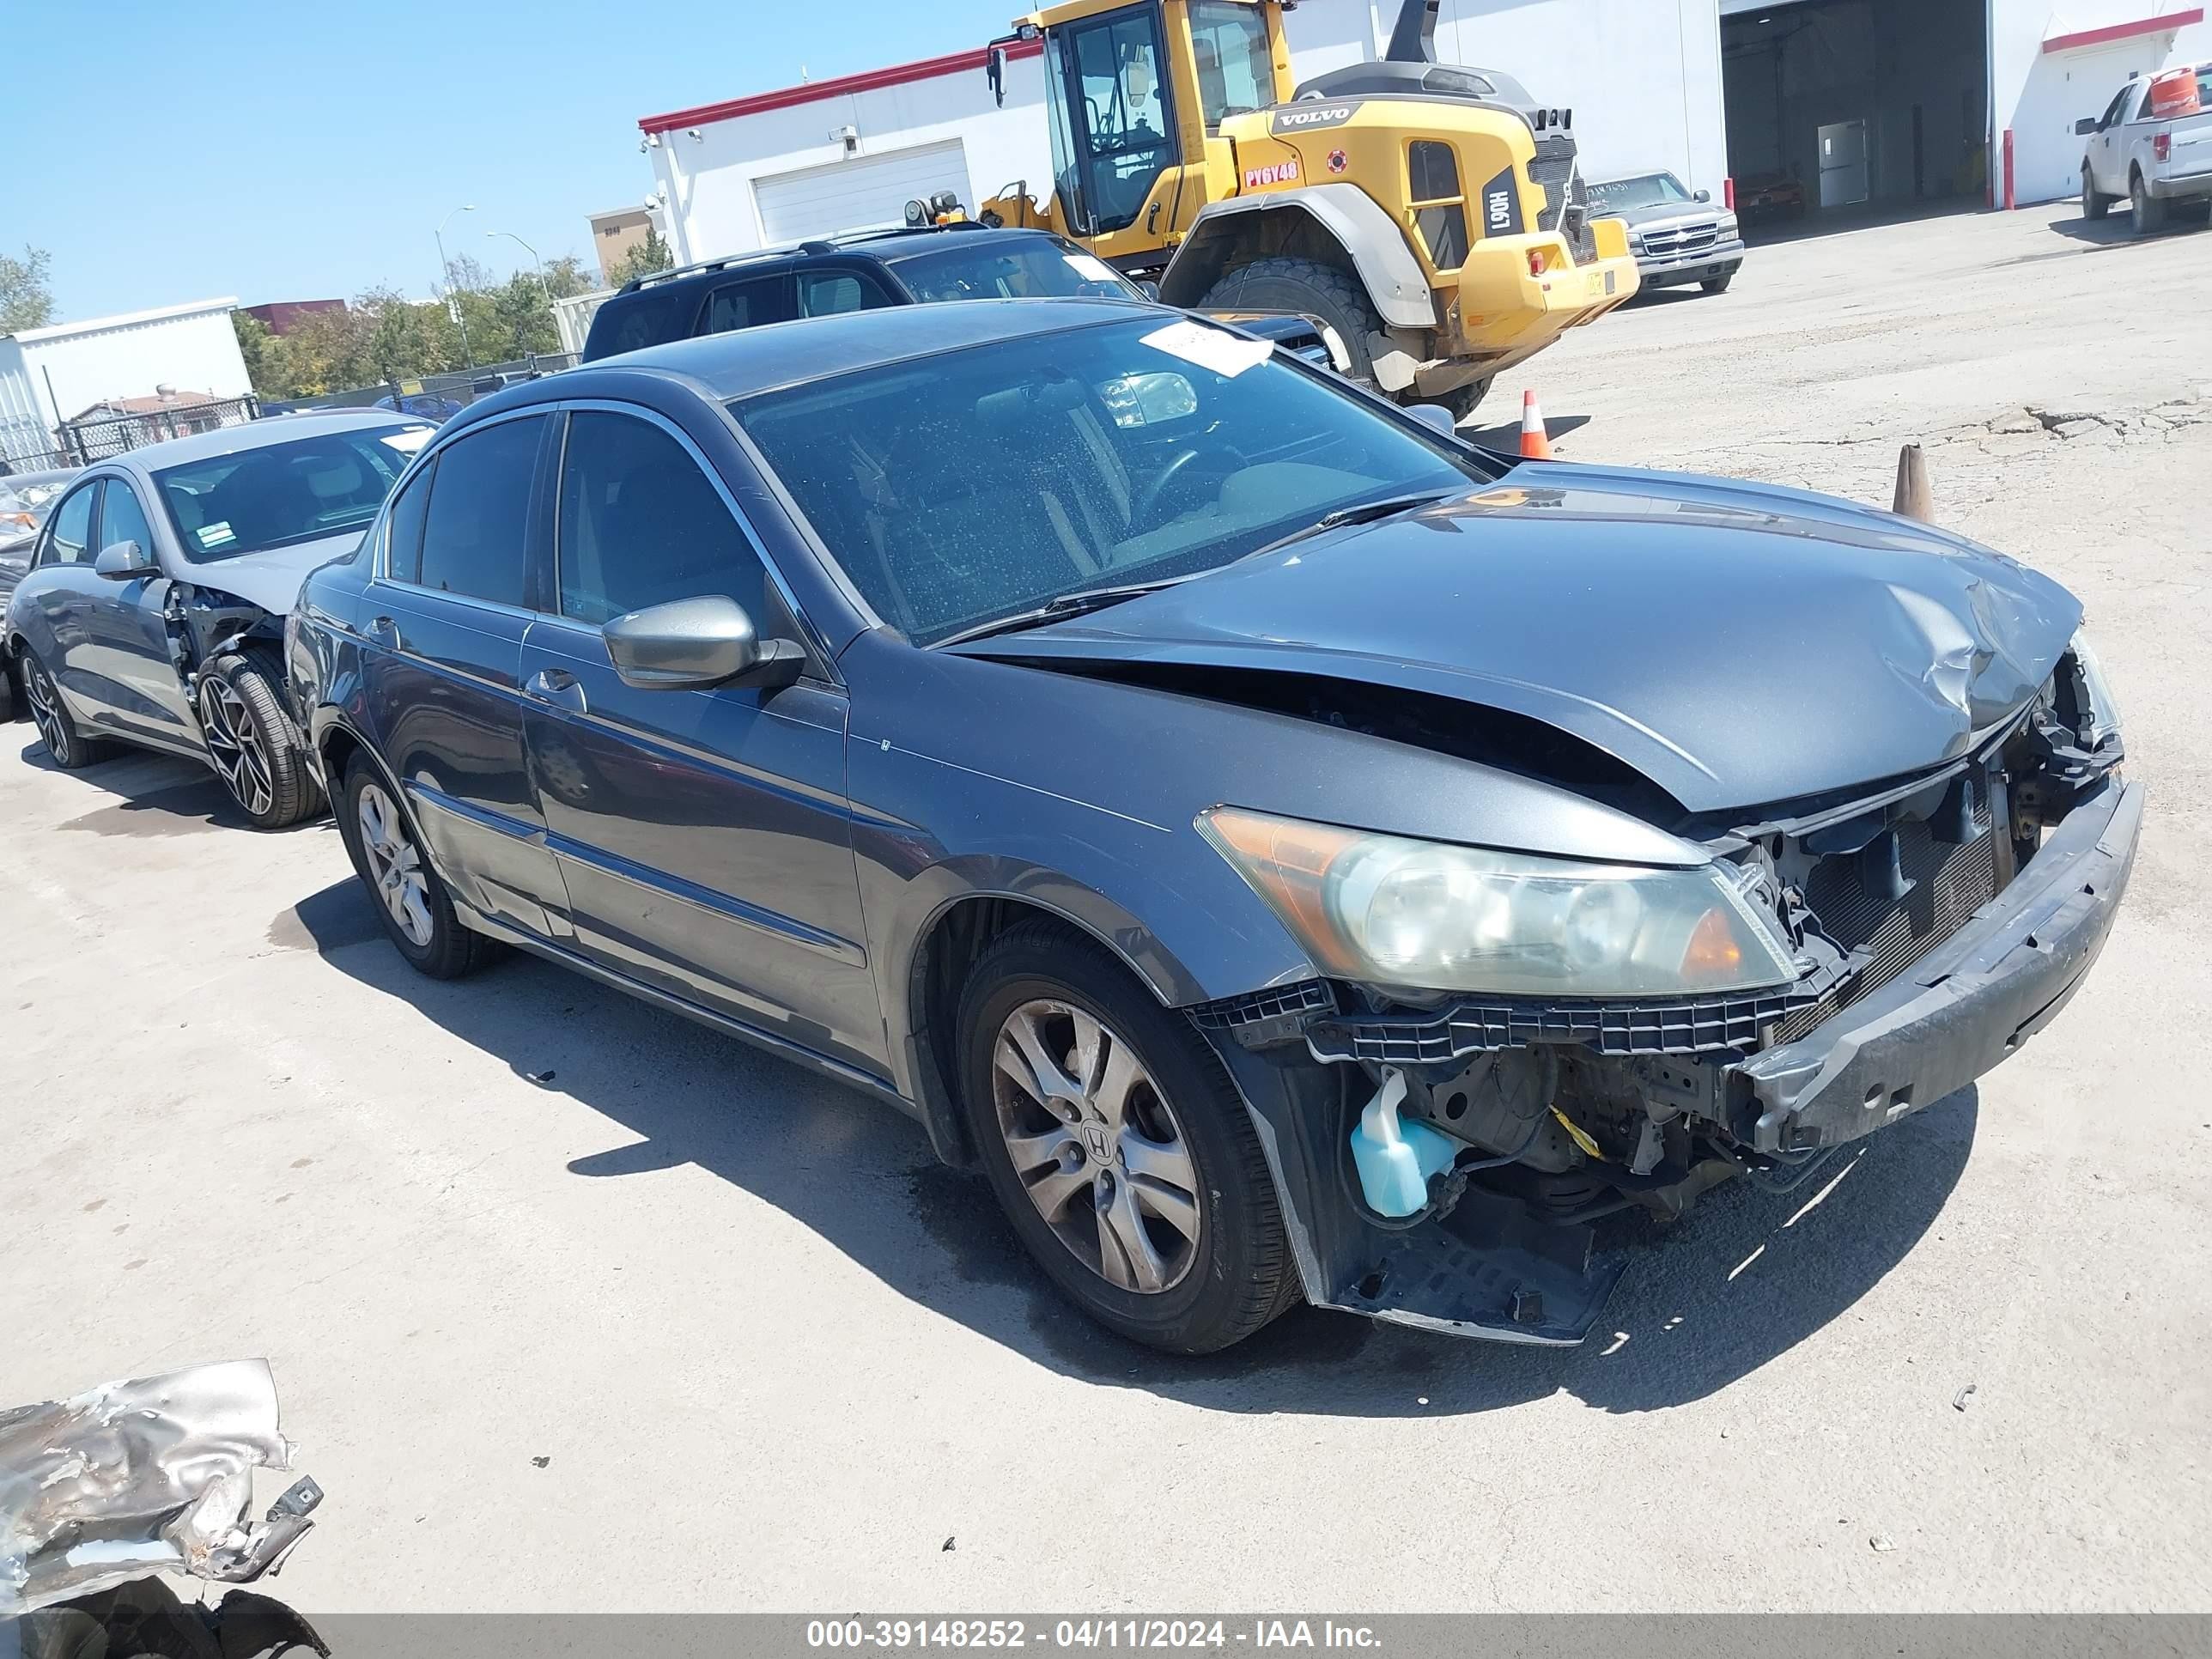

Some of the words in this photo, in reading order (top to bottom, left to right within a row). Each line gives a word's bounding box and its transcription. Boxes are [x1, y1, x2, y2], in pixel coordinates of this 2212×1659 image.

[1279, 108, 1350, 126] VOLVO
[1246, 162, 1298, 188] PY6Y48
[1489, 191, 1510, 229] L90H
